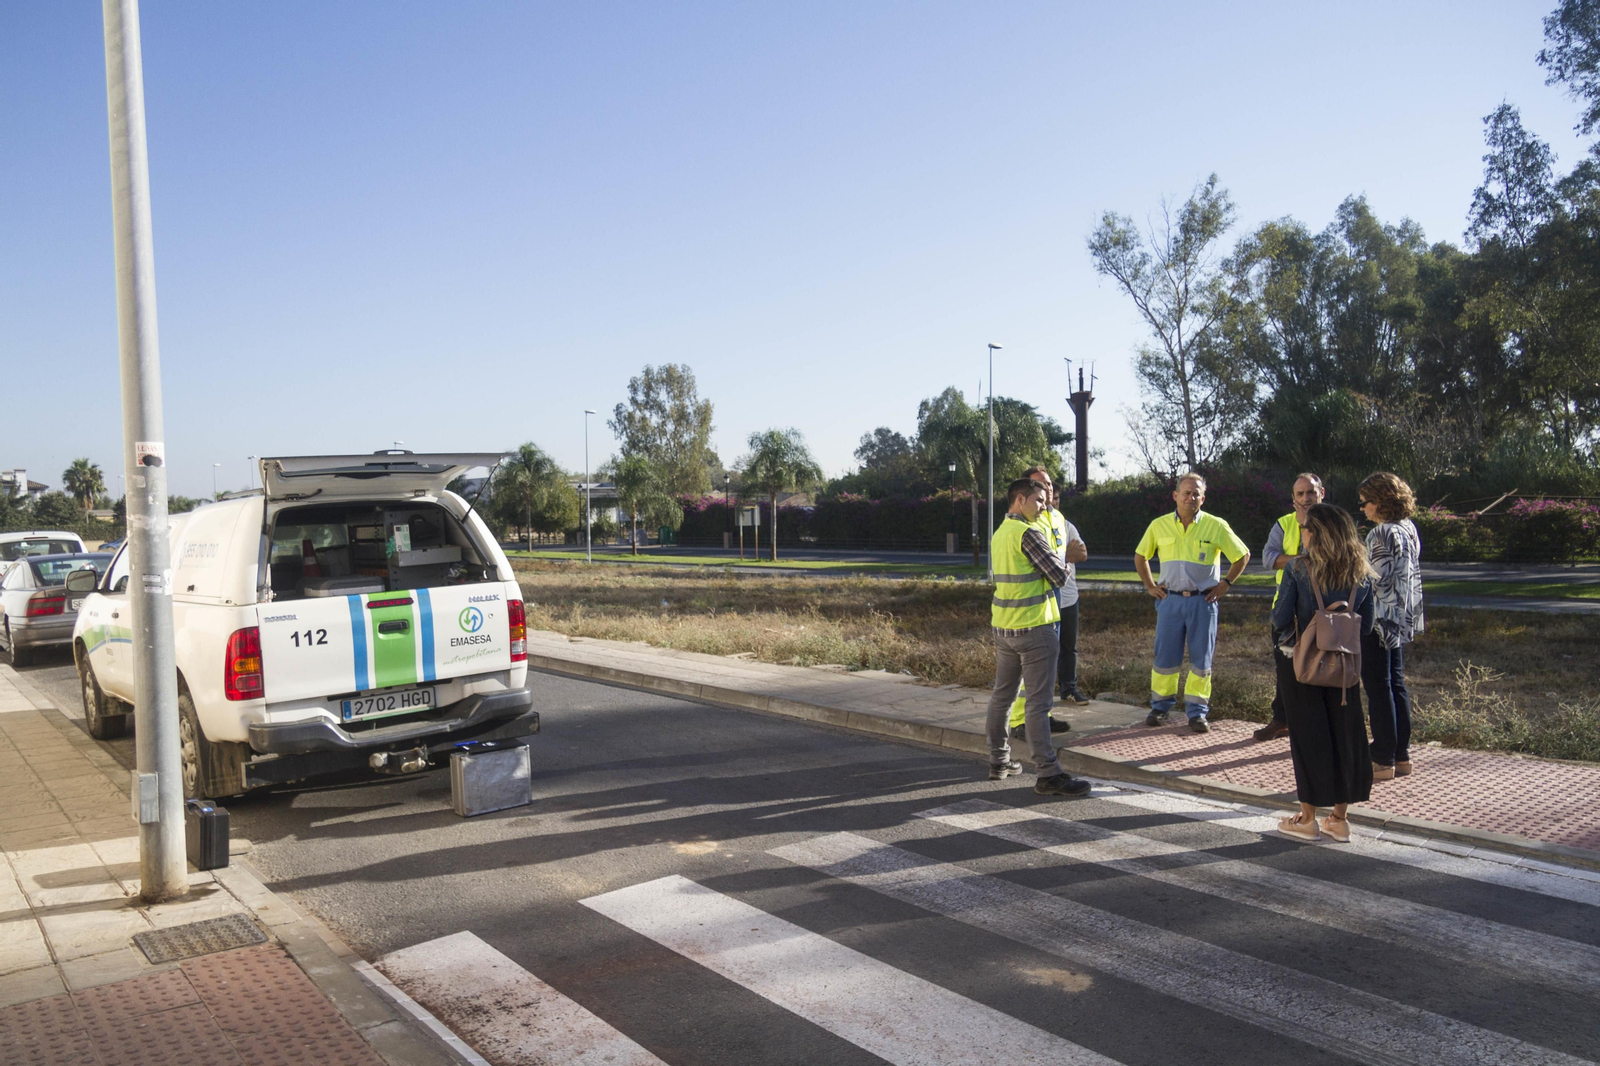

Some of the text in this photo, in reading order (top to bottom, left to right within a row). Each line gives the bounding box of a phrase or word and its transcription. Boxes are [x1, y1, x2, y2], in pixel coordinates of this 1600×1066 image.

[290, 628, 328, 648] 112
[450, 634, 492, 647] EMASESA
[442, 647, 502, 666] metropolitana
[354, 696, 396, 716] 2702
[401, 690, 431, 709] HGD
